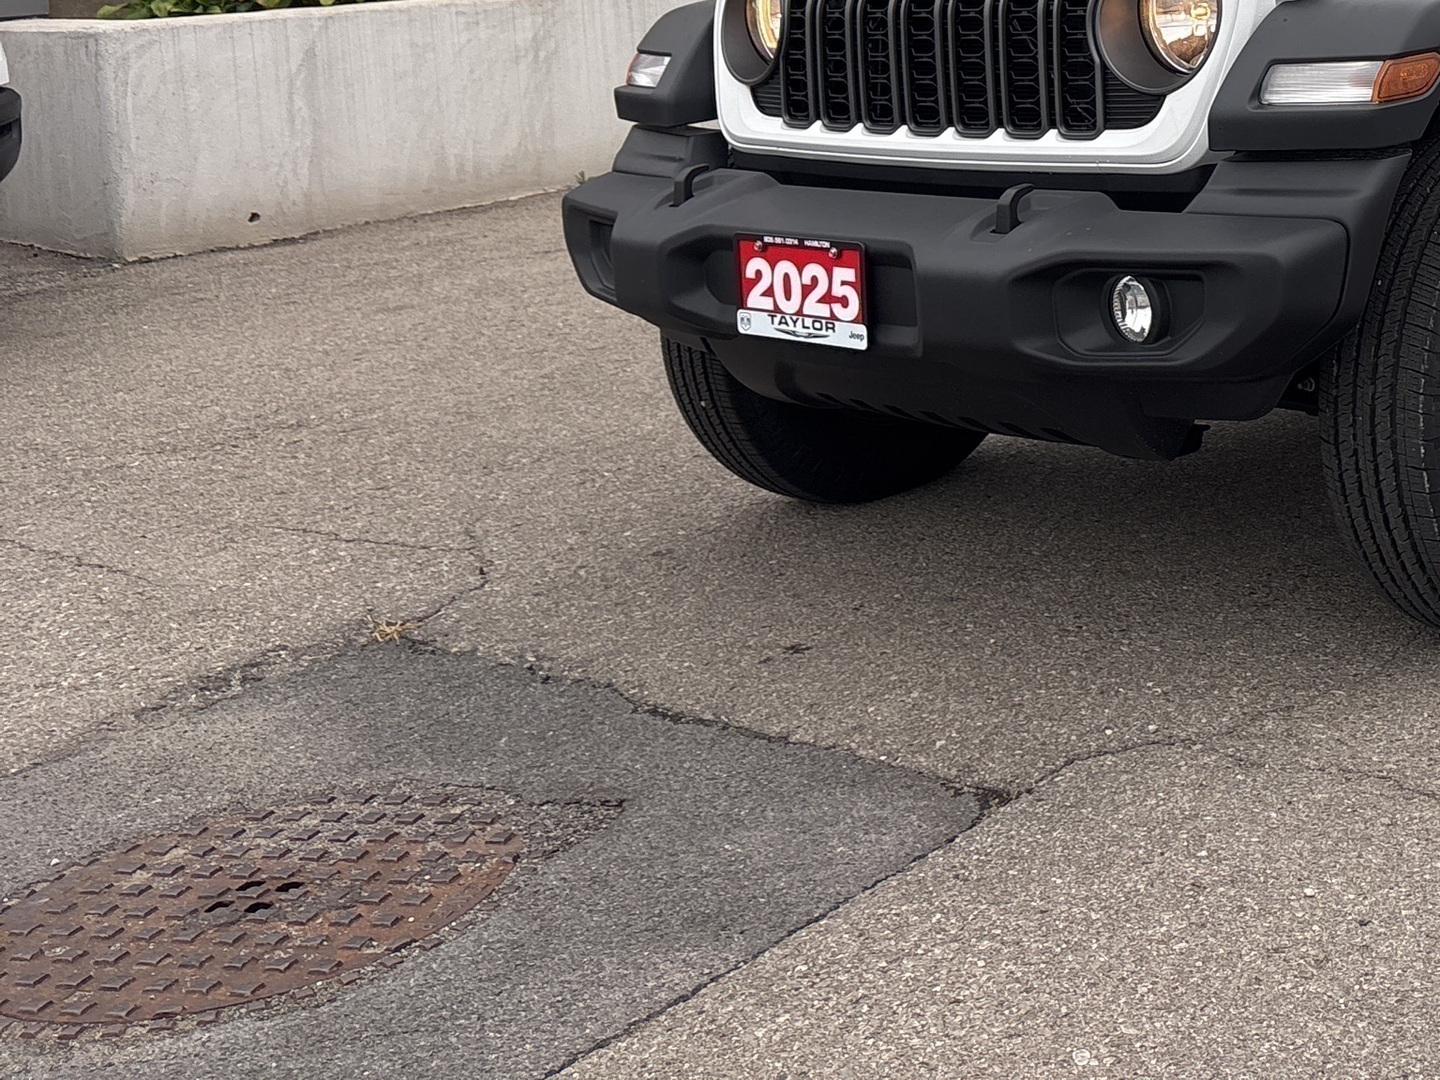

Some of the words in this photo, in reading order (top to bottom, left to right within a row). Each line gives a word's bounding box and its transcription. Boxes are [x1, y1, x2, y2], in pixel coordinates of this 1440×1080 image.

[745, 256, 860, 321] 2025
[767, 314, 836, 333] TAYLOR
[848, 331, 865, 341] Jeep
